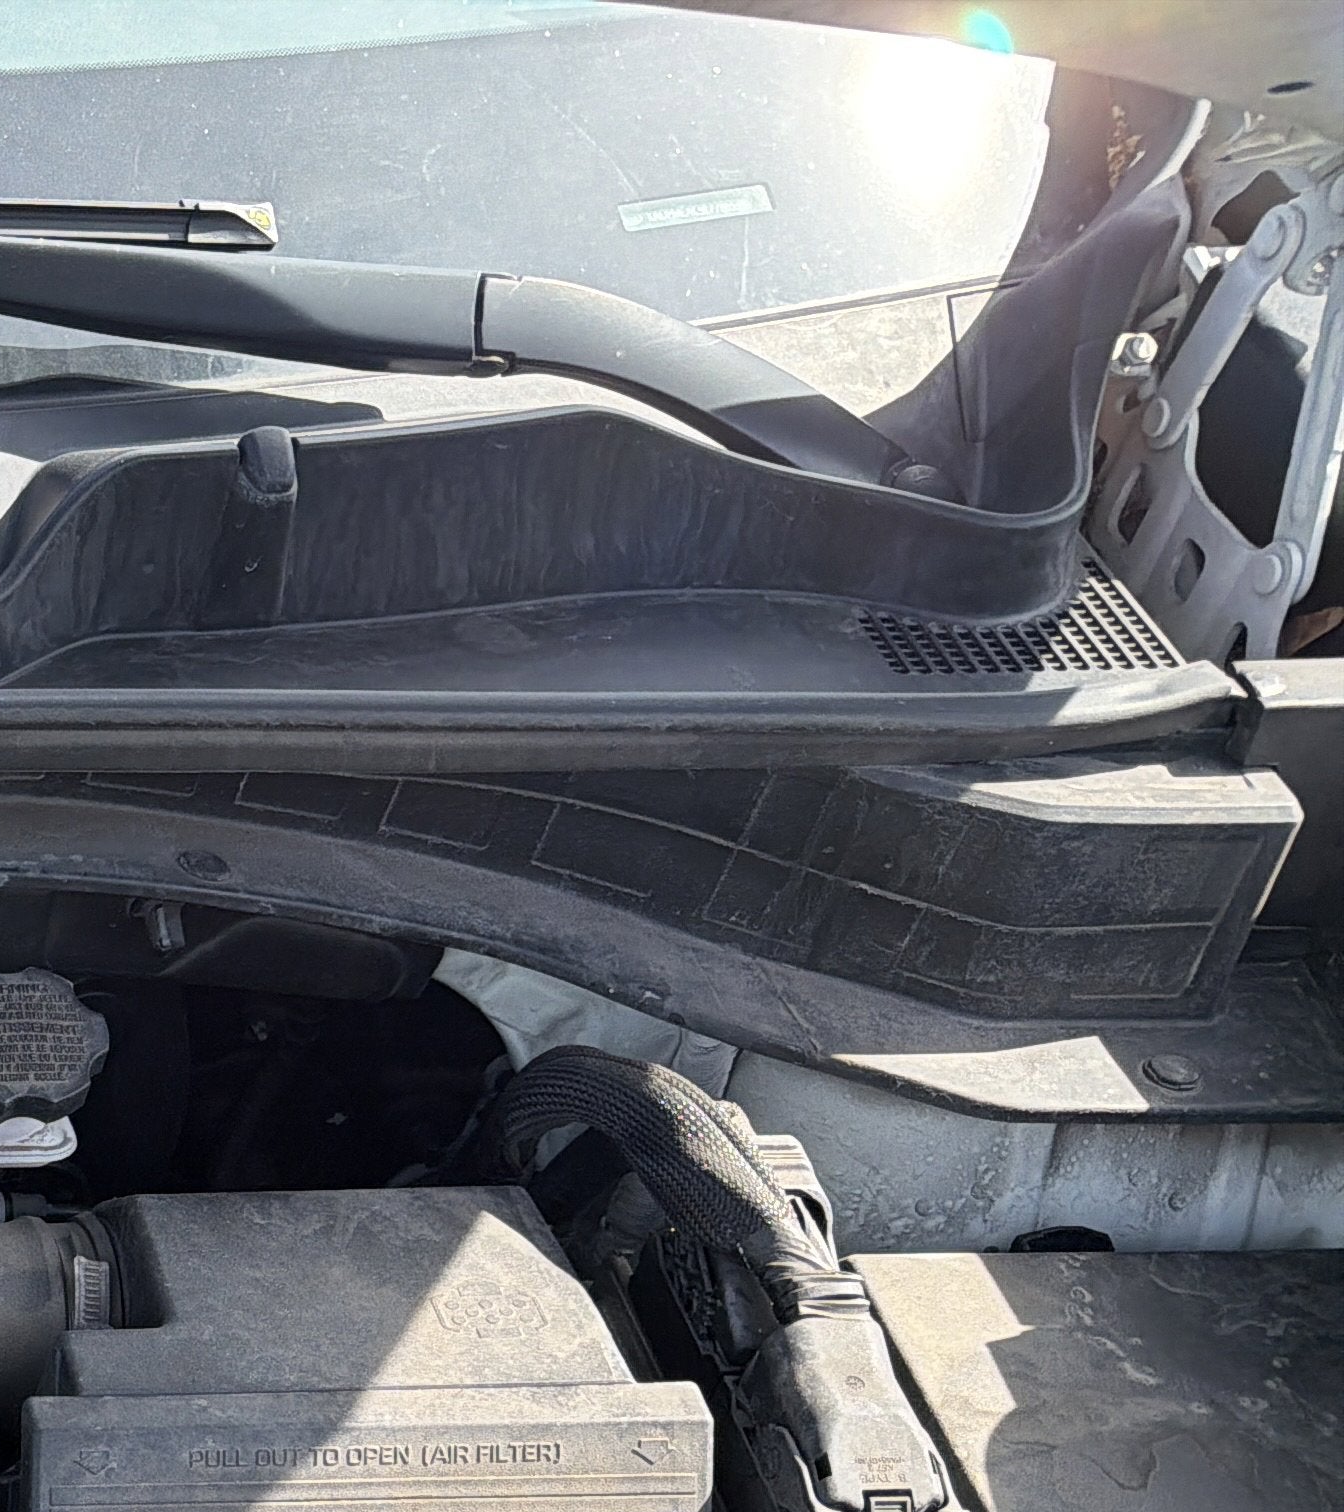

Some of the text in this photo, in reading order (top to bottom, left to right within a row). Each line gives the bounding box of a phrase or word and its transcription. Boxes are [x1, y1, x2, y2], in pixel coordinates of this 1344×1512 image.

[188, 1442, 562, 1468] PULL OUT TO OPEN (AIR FILTER)
